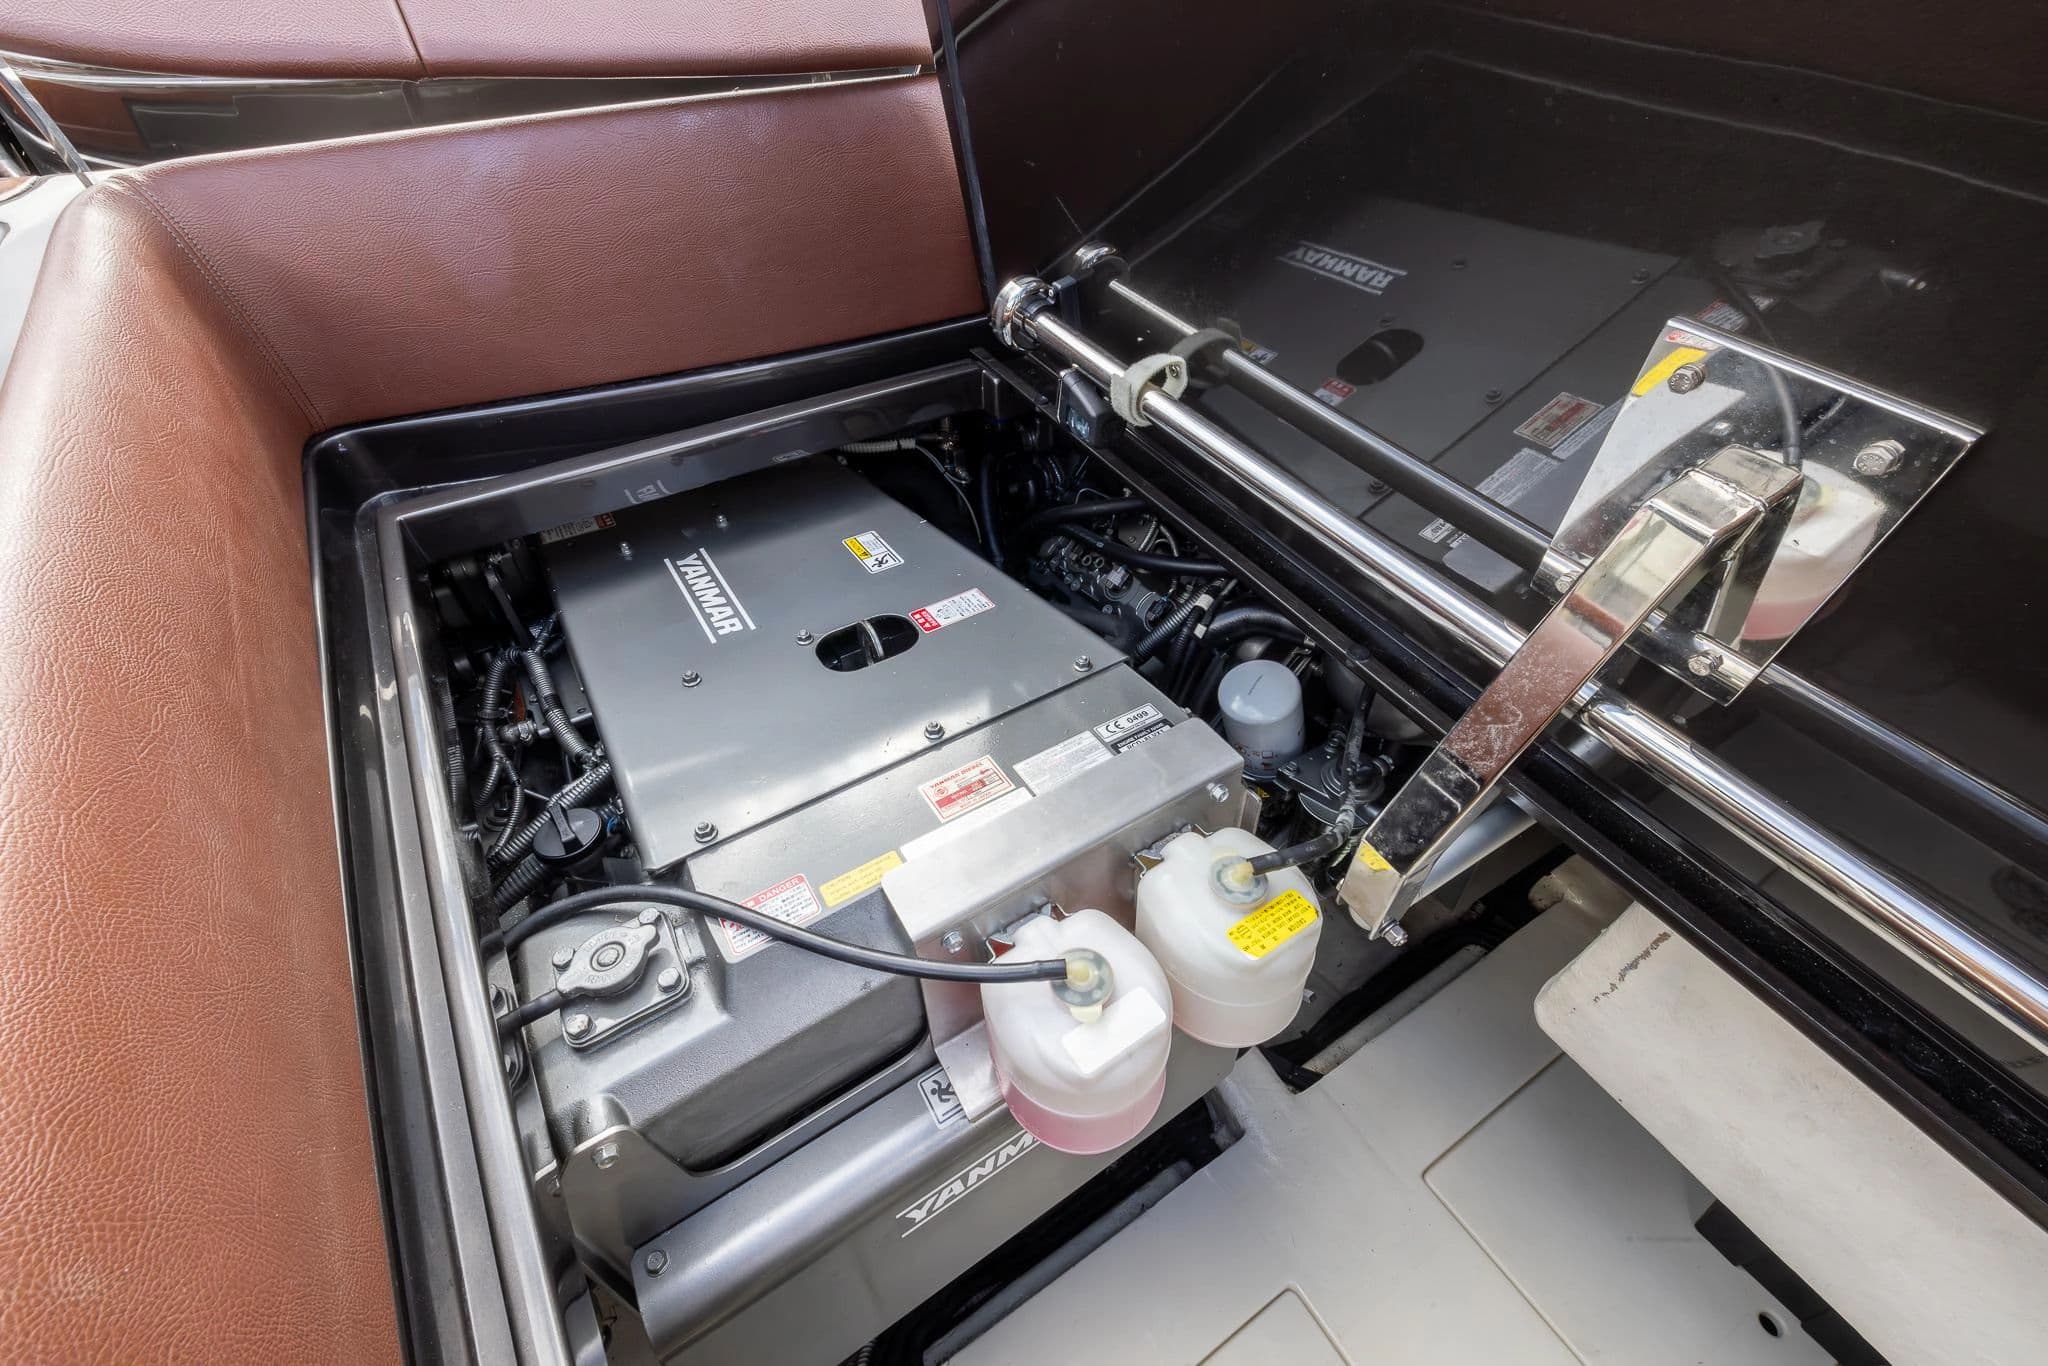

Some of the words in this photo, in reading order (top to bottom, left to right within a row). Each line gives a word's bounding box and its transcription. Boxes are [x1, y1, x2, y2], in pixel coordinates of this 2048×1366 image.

[676, 553, 744, 635] YANMAR
[1105, 720, 1125, 733] CE
[1126, 710, 1149, 724] 0499
[758, 878, 800, 902] DANGER
[905, 1133, 1038, 1223] YANM
